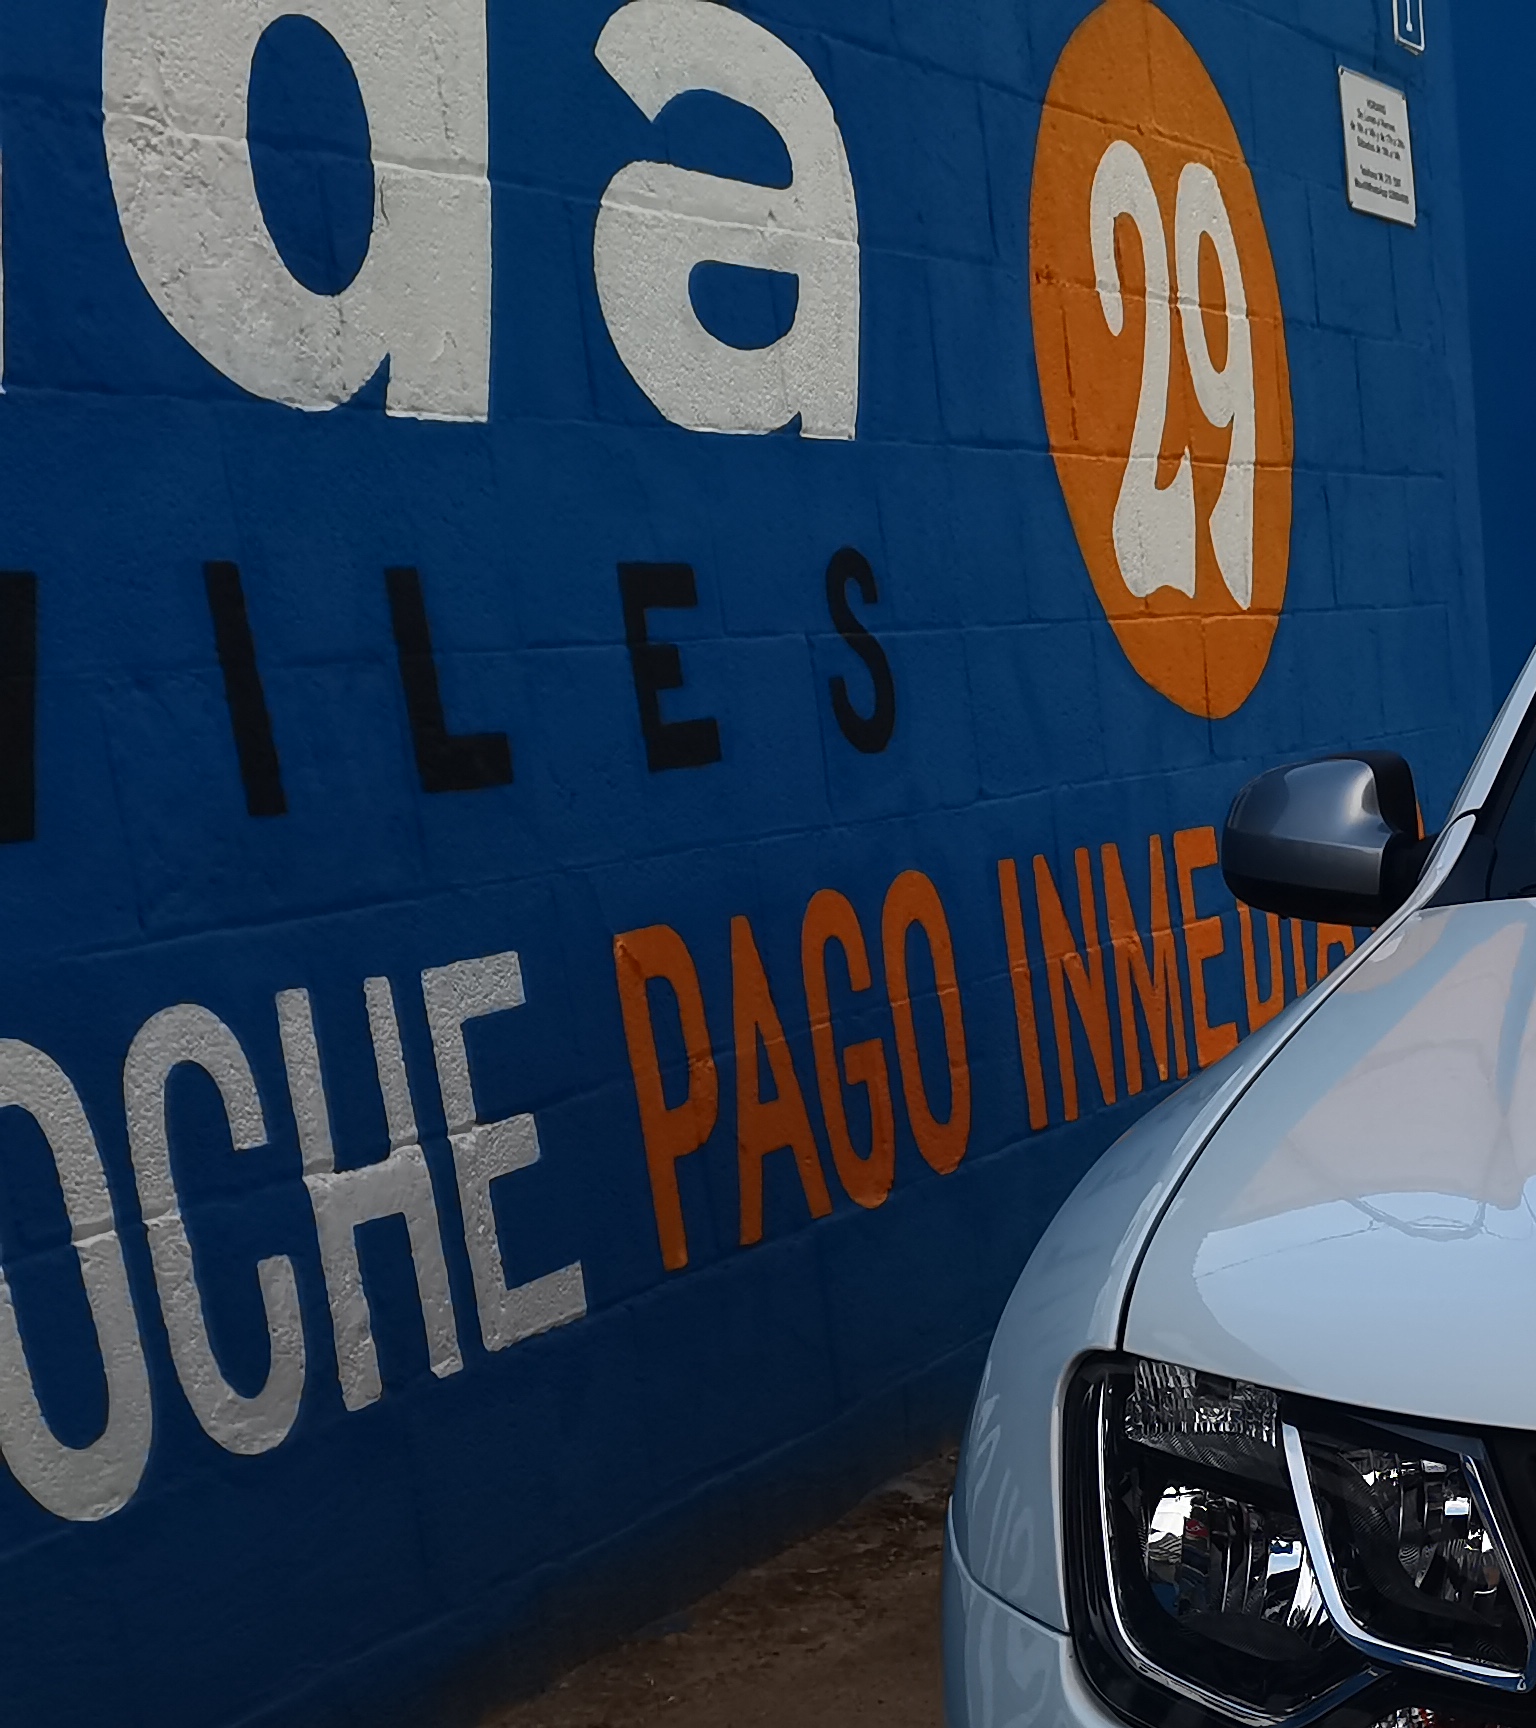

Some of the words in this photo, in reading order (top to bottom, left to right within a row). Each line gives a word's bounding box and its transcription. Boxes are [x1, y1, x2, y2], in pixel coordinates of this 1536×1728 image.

[0, 0, 860, 441] da
[1089, 139, 1256, 610] 29
[613, 869, 972, 1272] PAGO
